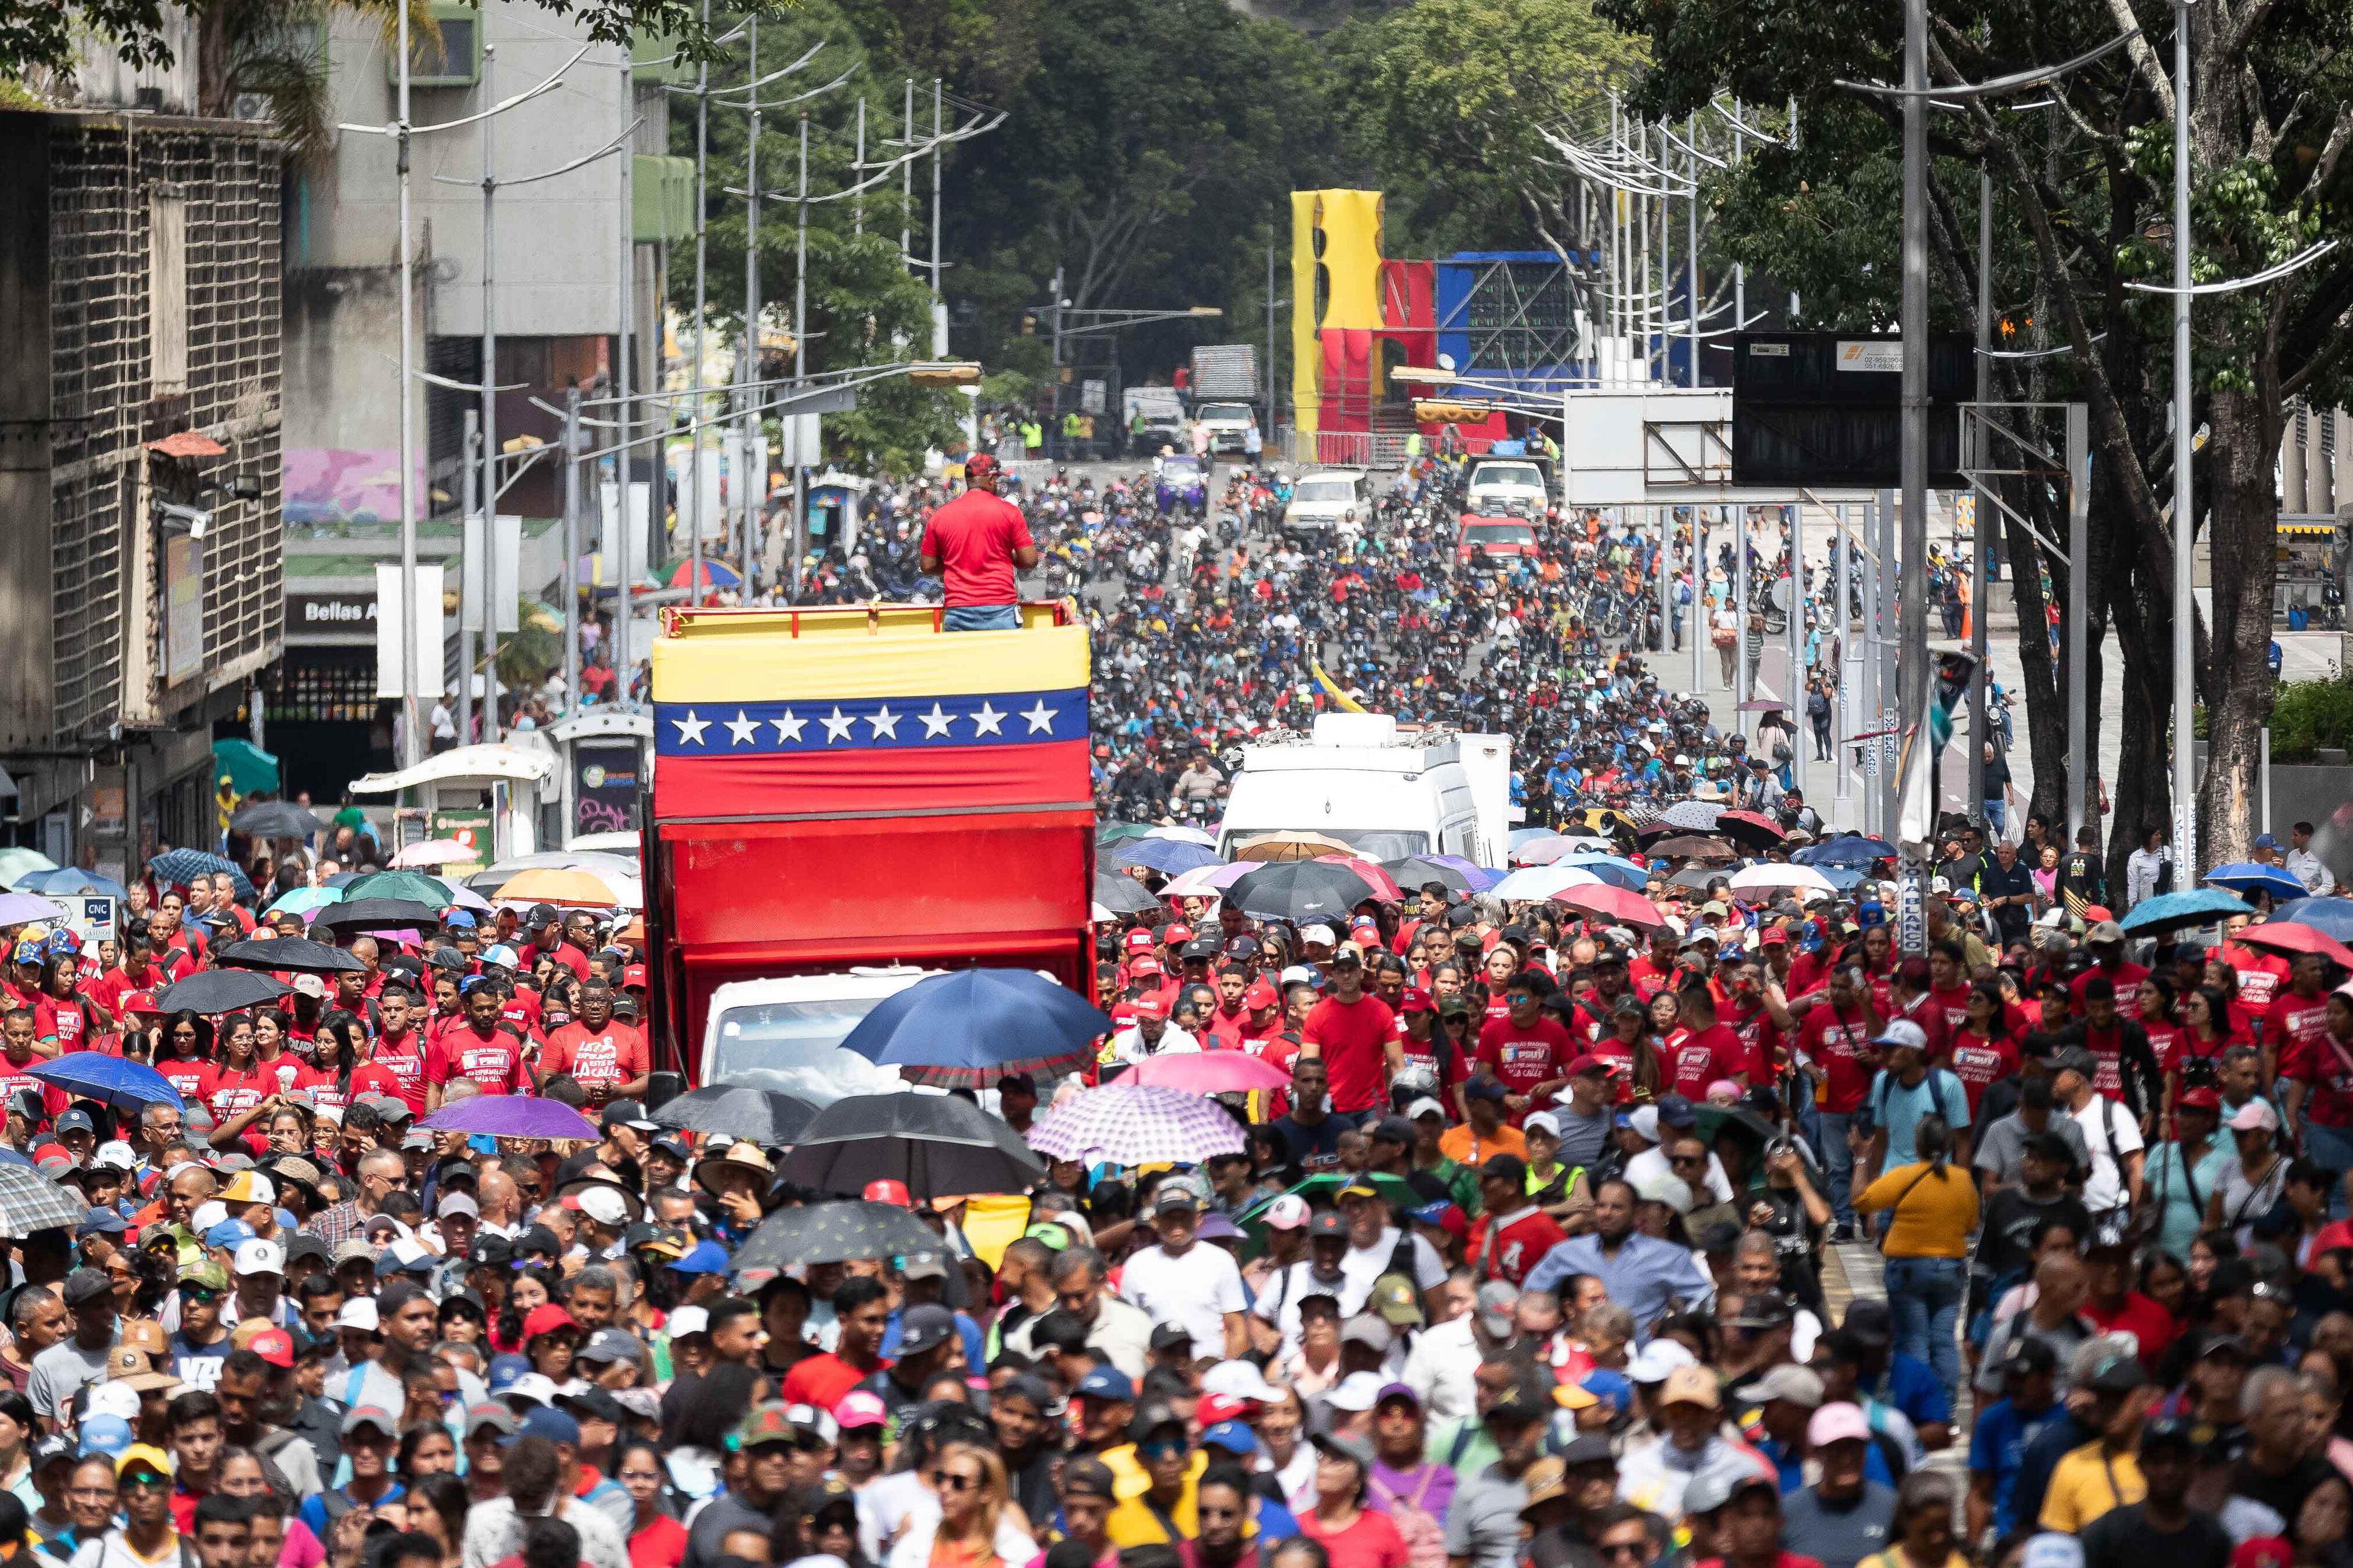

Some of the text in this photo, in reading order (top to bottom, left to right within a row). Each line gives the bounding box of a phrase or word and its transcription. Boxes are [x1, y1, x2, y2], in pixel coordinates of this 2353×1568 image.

[306, 601, 362, 621] Bellas
[88, 904, 107, 914] CNC
[1904, 860, 1922, 949] VOTA BLANCO
[572, 1060, 620, 1078] LA CALLE
